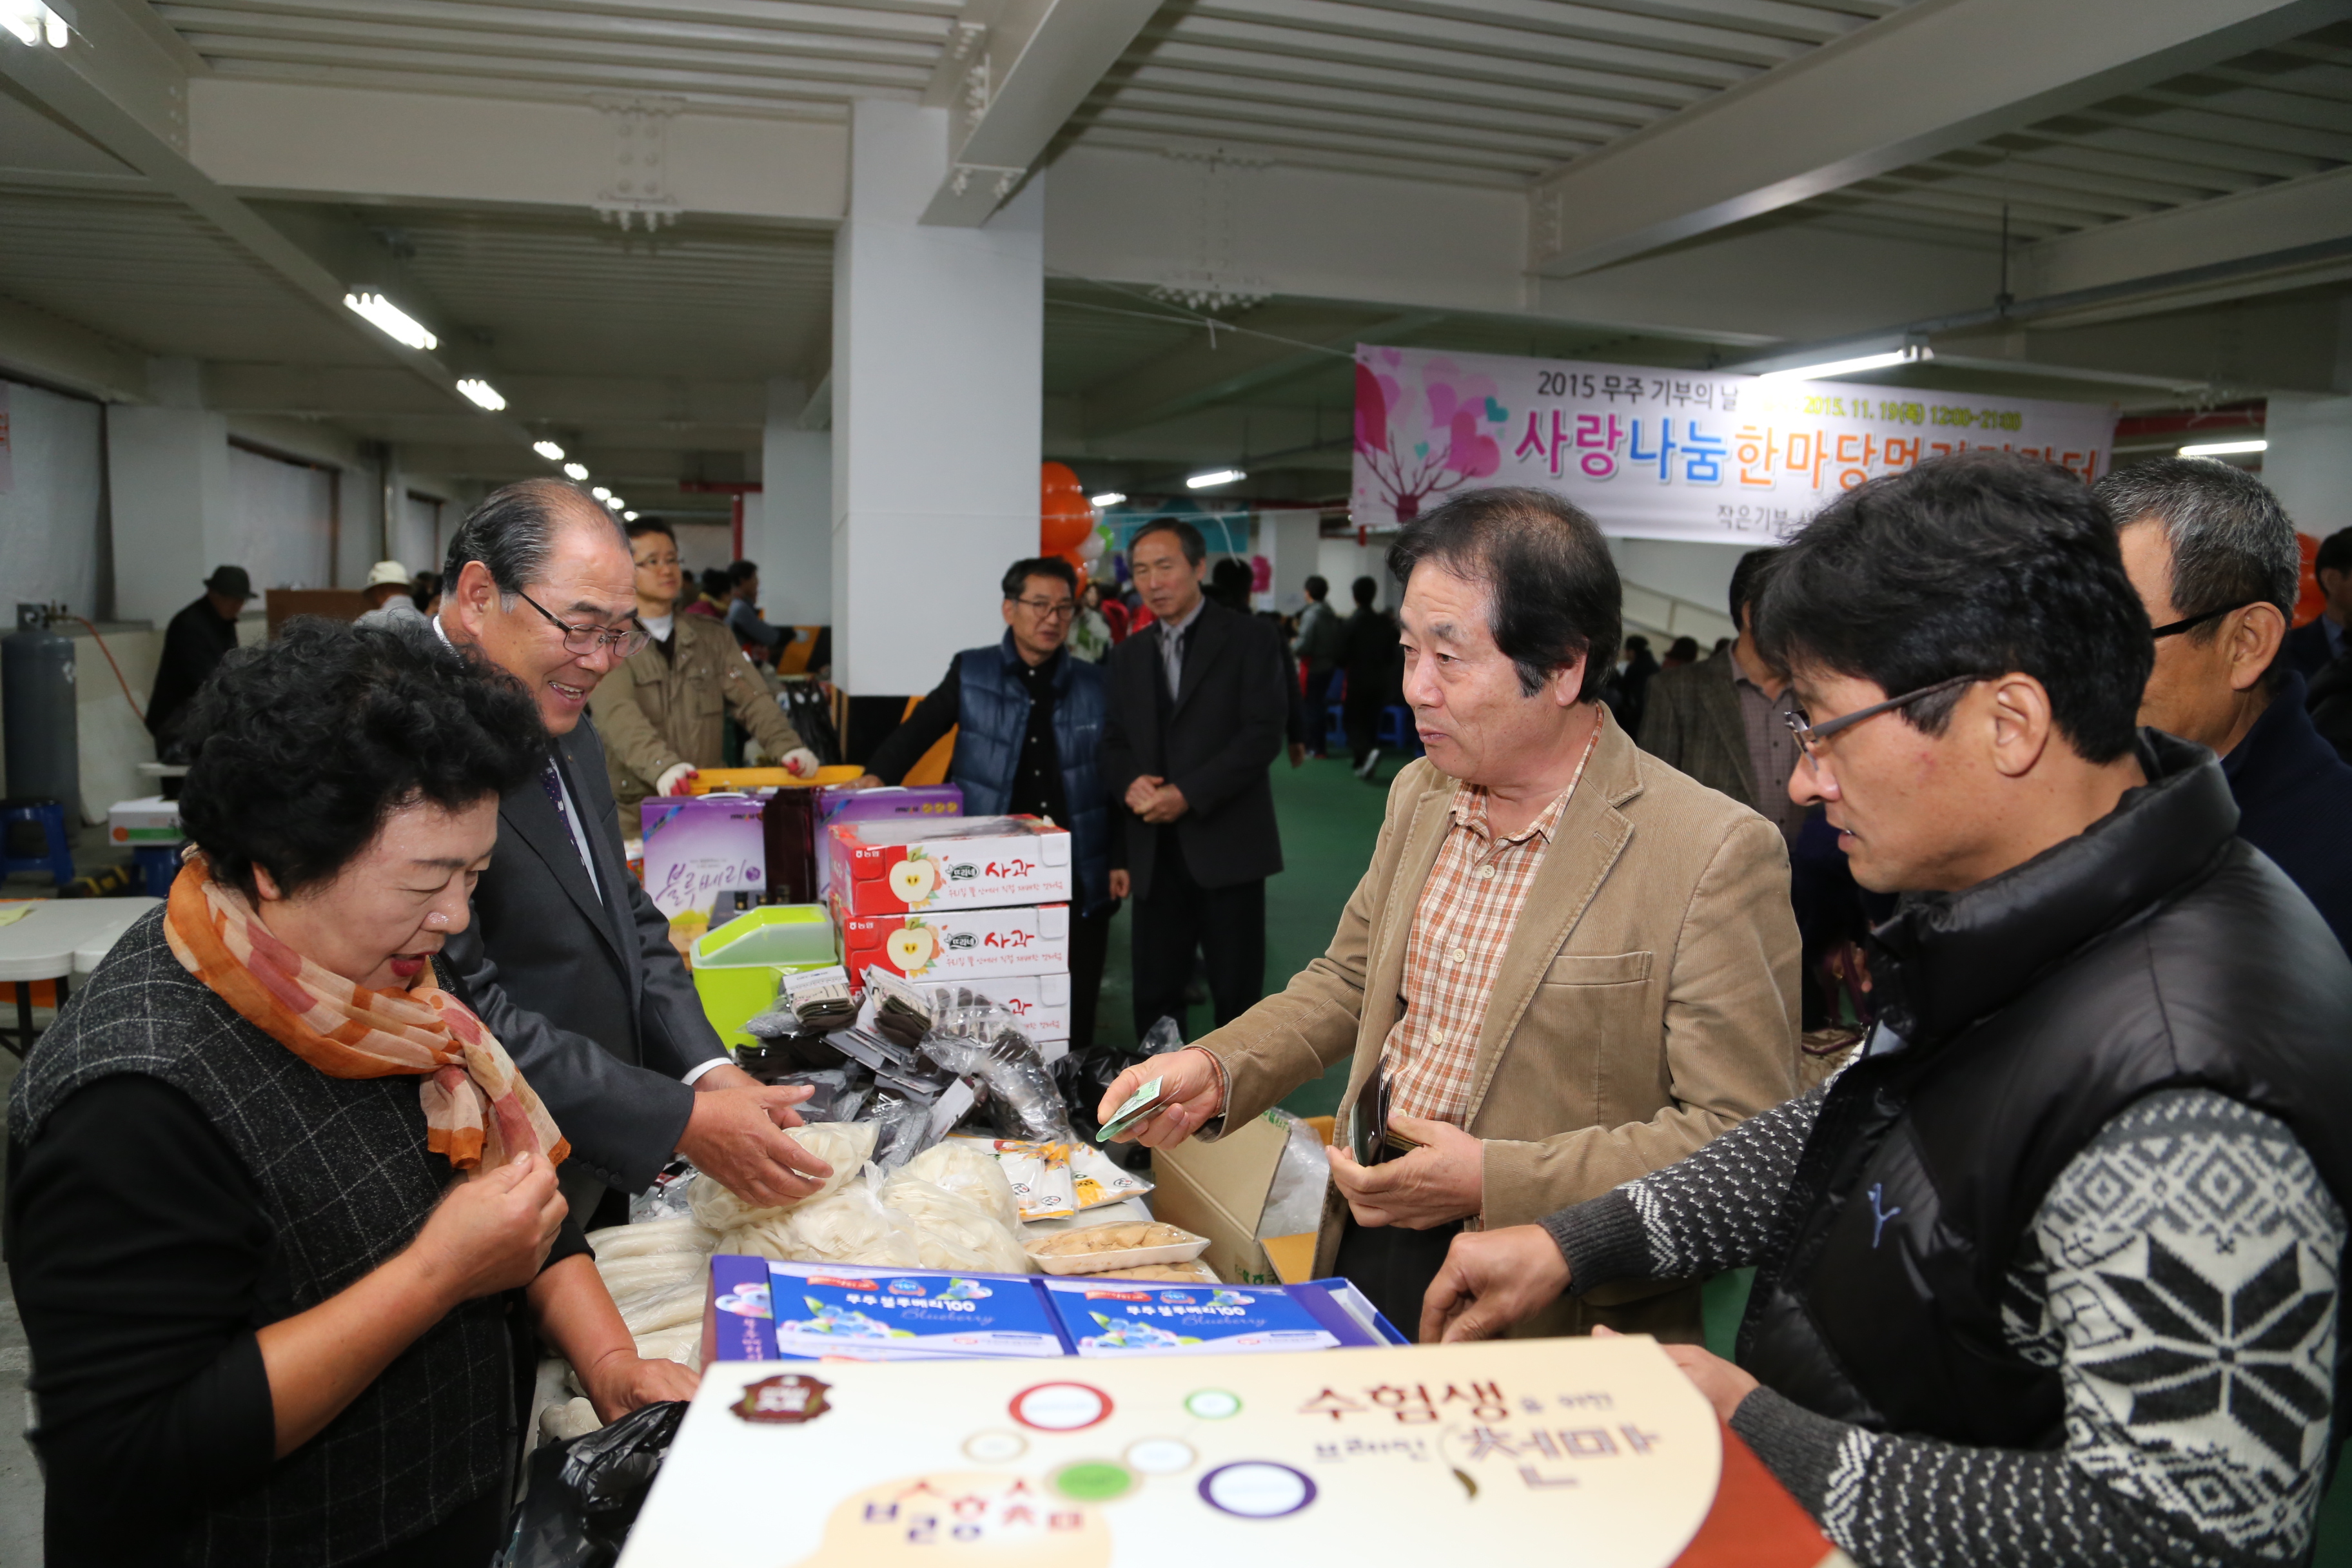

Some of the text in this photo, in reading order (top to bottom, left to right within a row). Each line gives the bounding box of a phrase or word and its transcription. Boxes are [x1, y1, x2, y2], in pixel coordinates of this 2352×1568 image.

[1538, 371, 1596, 398] 2015
[1602, 375, 1644, 404] 무주
[1651, 379, 1713, 409] 기부의
[1721, 386, 1739, 411] 날
[985, 859, 1035, 878] 사과
[984, 929, 1035, 948] 사과
[900, 1307, 995, 1326] Blueberry
[1181, 1314, 1266, 1328] Blueberry
[1297, 1380, 1511, 1424] 수험생
